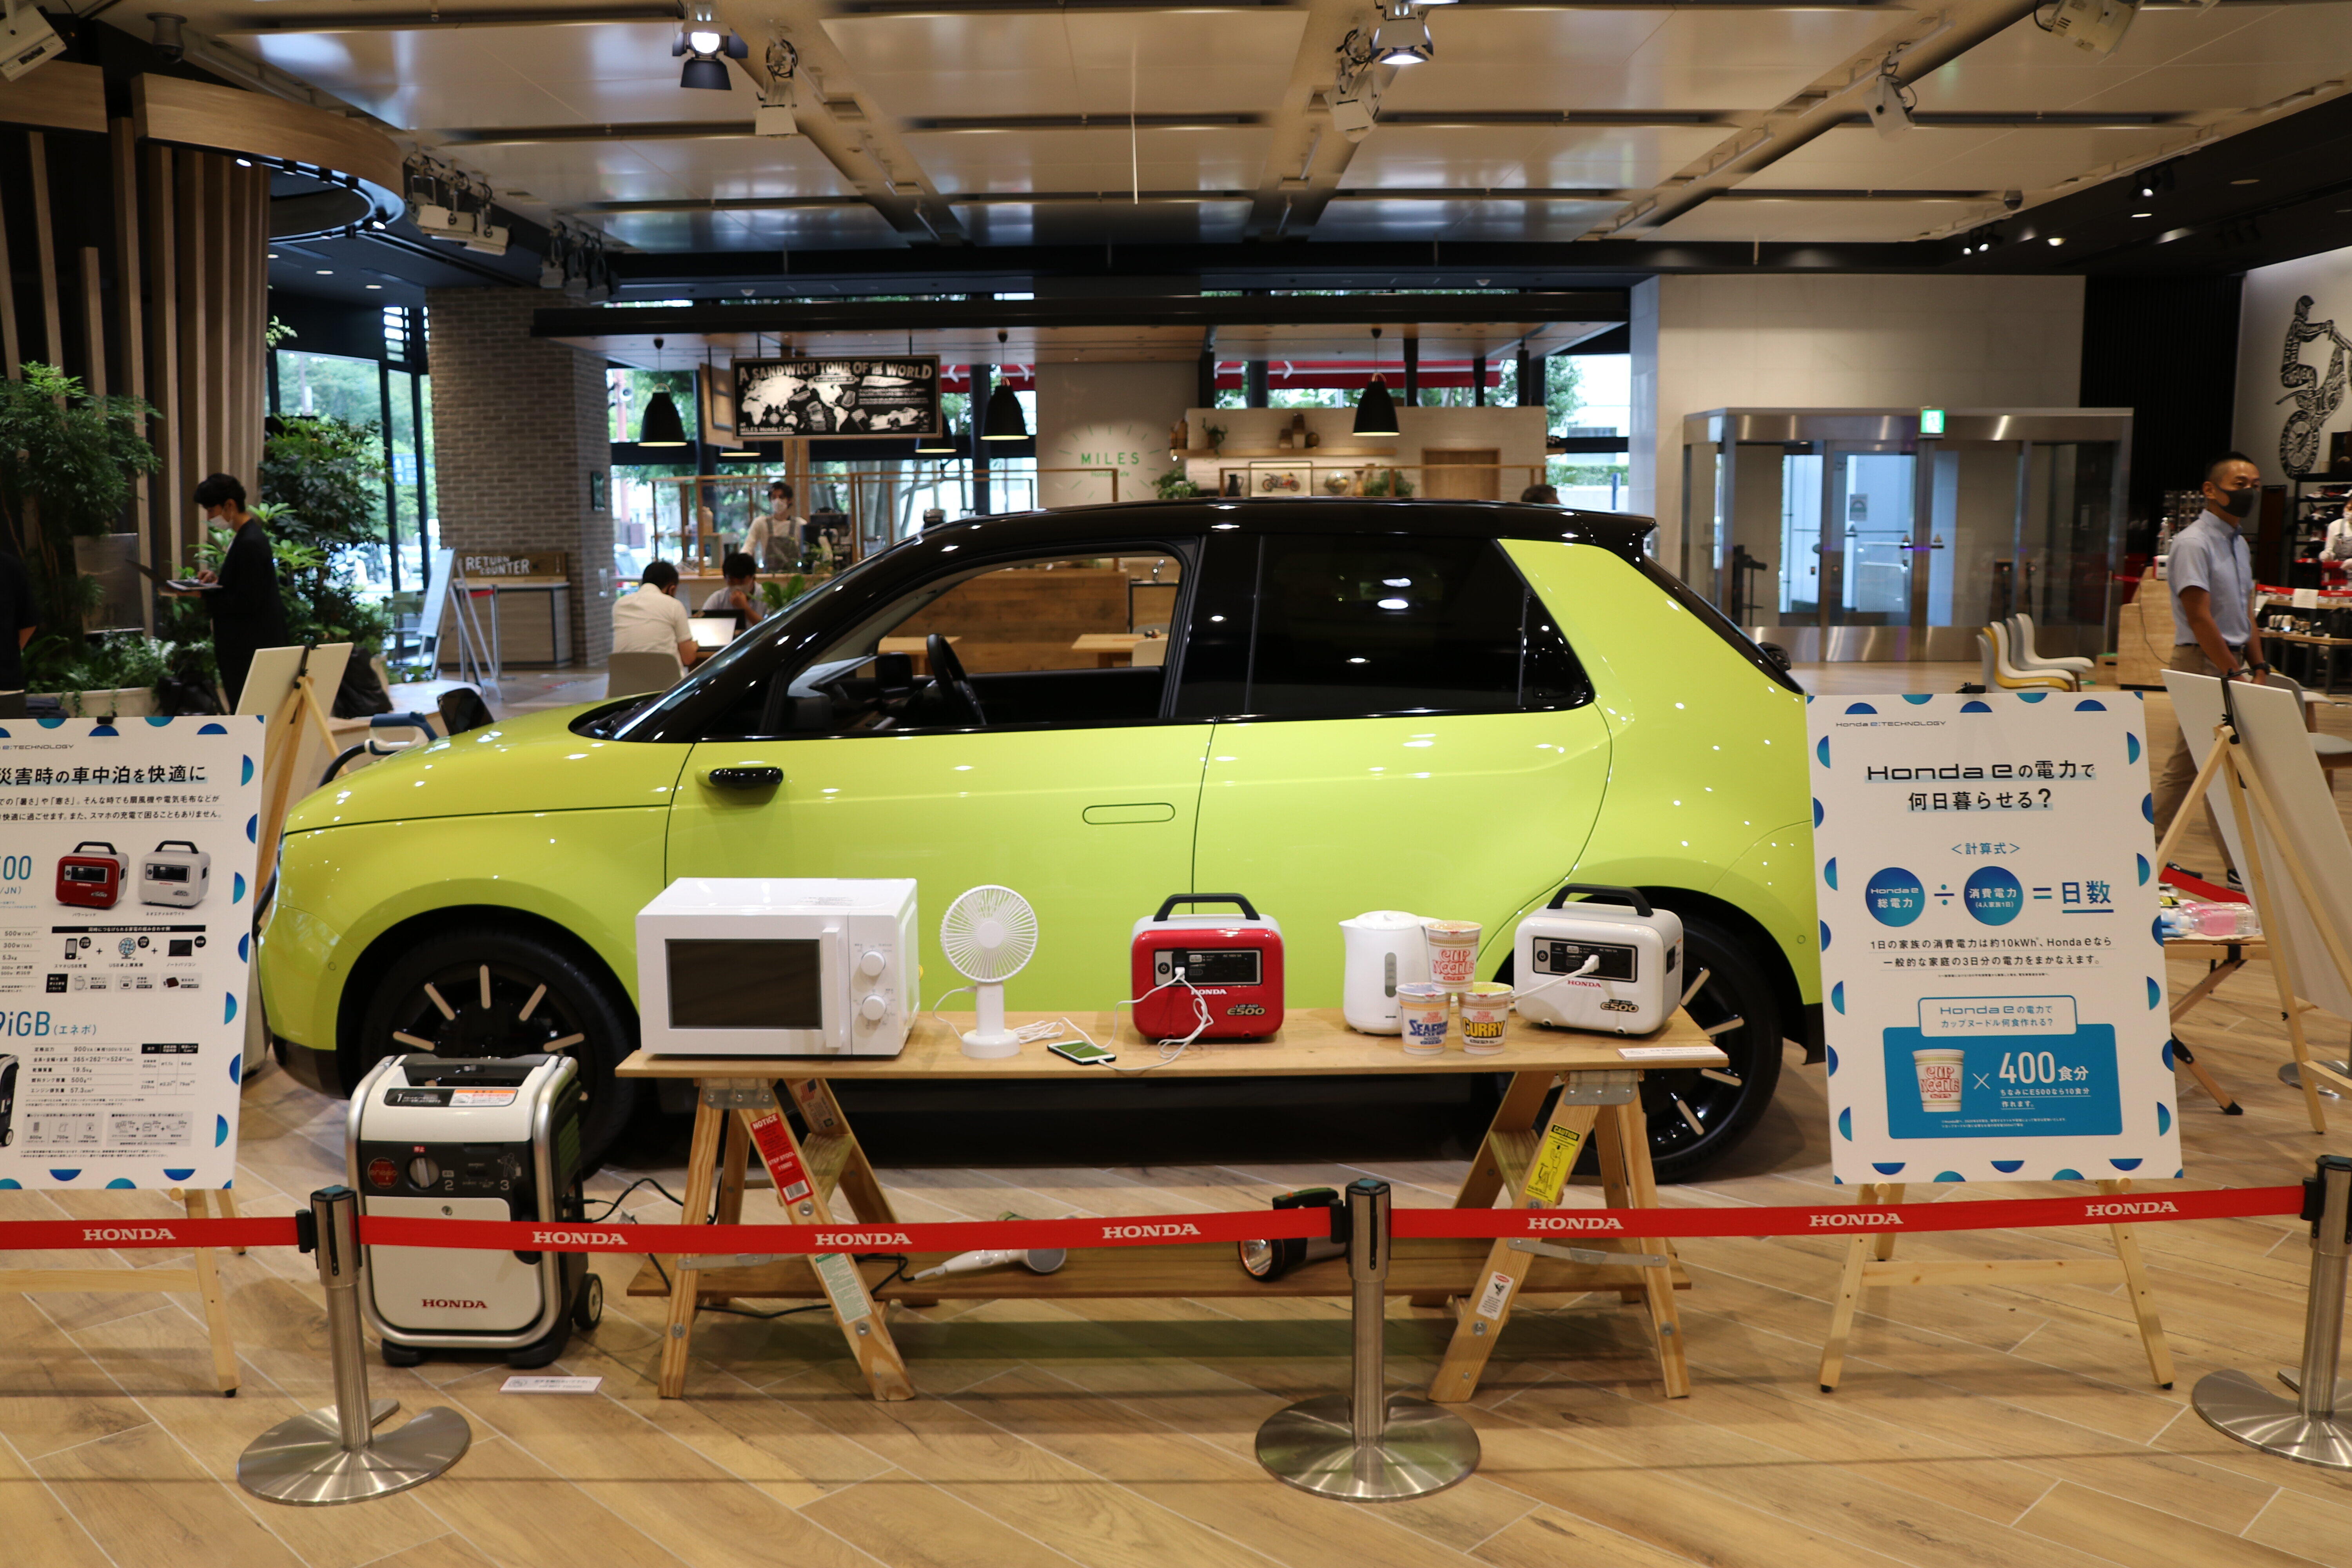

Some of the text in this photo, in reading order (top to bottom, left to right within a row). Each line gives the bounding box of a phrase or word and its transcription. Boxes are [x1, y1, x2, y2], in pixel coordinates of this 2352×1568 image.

[739, 367, 749, 385] A
[752, 362, 817, 379] SANDWICH
[818, 361, 851, 375] TOUR
[853, 361, 869, 374] OF
[886, 363, 932, 379] WORLD
[1081, 452, 1139, 465] MILES
[465, 555, 509, 572] RETURN
[480, 558, 530, 575] COUNTER
[0, 765, 205, 786] 災害時の車中泊を快適に
[1867, 763, 1984, 781] Honda
[1908, 788, 2052, 811] 何日暮らせる?
[0, 811, 221, 821] 快適に過ごせます。また、スマホの充電で困ることもありません。
[0, 855, 32, 880] 00
[1870, 887, 1909, 895] Honda
[1968, 887, 2017, 899] 消費電力
[2062, 880, 2112, 906] 日数
[1877, 898, 1914, 909] 総電力
[1439, 949, 1471, 962] CUP
[1883, 955, 2100, 967] 一般的な家庭の3日分の電力をまかなえます。
[1432, 960, 1475, 975] NOODLE
[1601, 1004, 1639, 1012] E500
[1940, 1006, 2000, 1015] Honda
[1463, 1017, 1505, 1038] CURRY
[1940, 1018, 2053, 1028] カップヌードル何食作れる?
[1925, 1066, 1954, 1080] CUP
[1920, 1078, 1959, 1093] NOODLE
[2000, 1087, 2091, 1096] ちなみにE500なら10食分
[2002, 1100, 2035, 1109] 作れます。
[752, 1114, 778, 1129] NOTICE
[444, 1180, 510, 1191] 2 3
[2085, 1201, 2179, 1217] HONDA
[1527, 1217, 1624, 1230] HONDA
[1809, 1212, 1904, 1227] HONDA
[83, 1228, 176, 1241] HONDA
[1102, 1223, 1201, 1239] HONDA
[532, 1231, 627, 1246] HONDA
[815, 1232, 912, 1246] HONDA
[421, 1299, 488, 1308] HONDA
